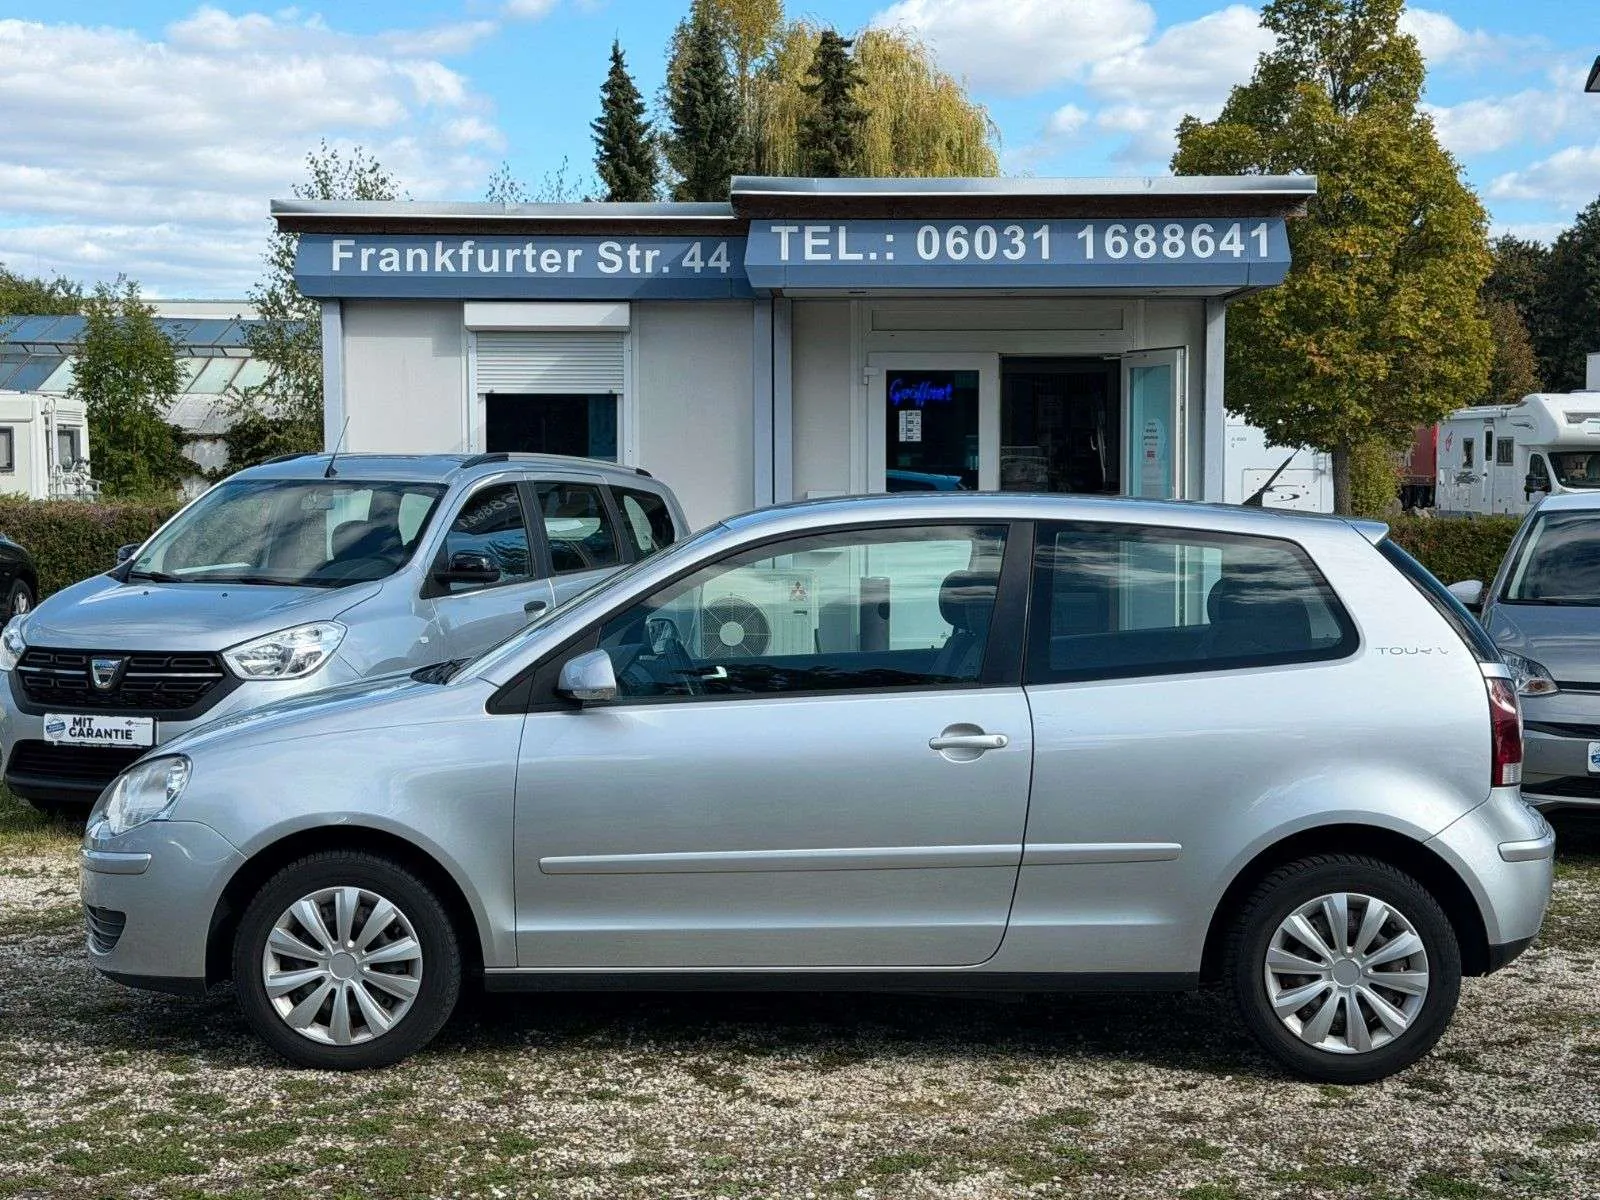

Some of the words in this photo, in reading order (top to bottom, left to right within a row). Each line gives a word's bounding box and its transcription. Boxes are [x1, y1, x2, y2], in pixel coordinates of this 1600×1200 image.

[331, 238, 582, 273] Frankfurter
[597, 241, 670, 274] Str.
[682, 241, 730, 273] 44
[771, 225, 894, 261] TEL.:
[916, 224, 1051, 261] 06031
[1078, 222, 1270, 259] 1688641
[72, 717, 94, 728] MIT
